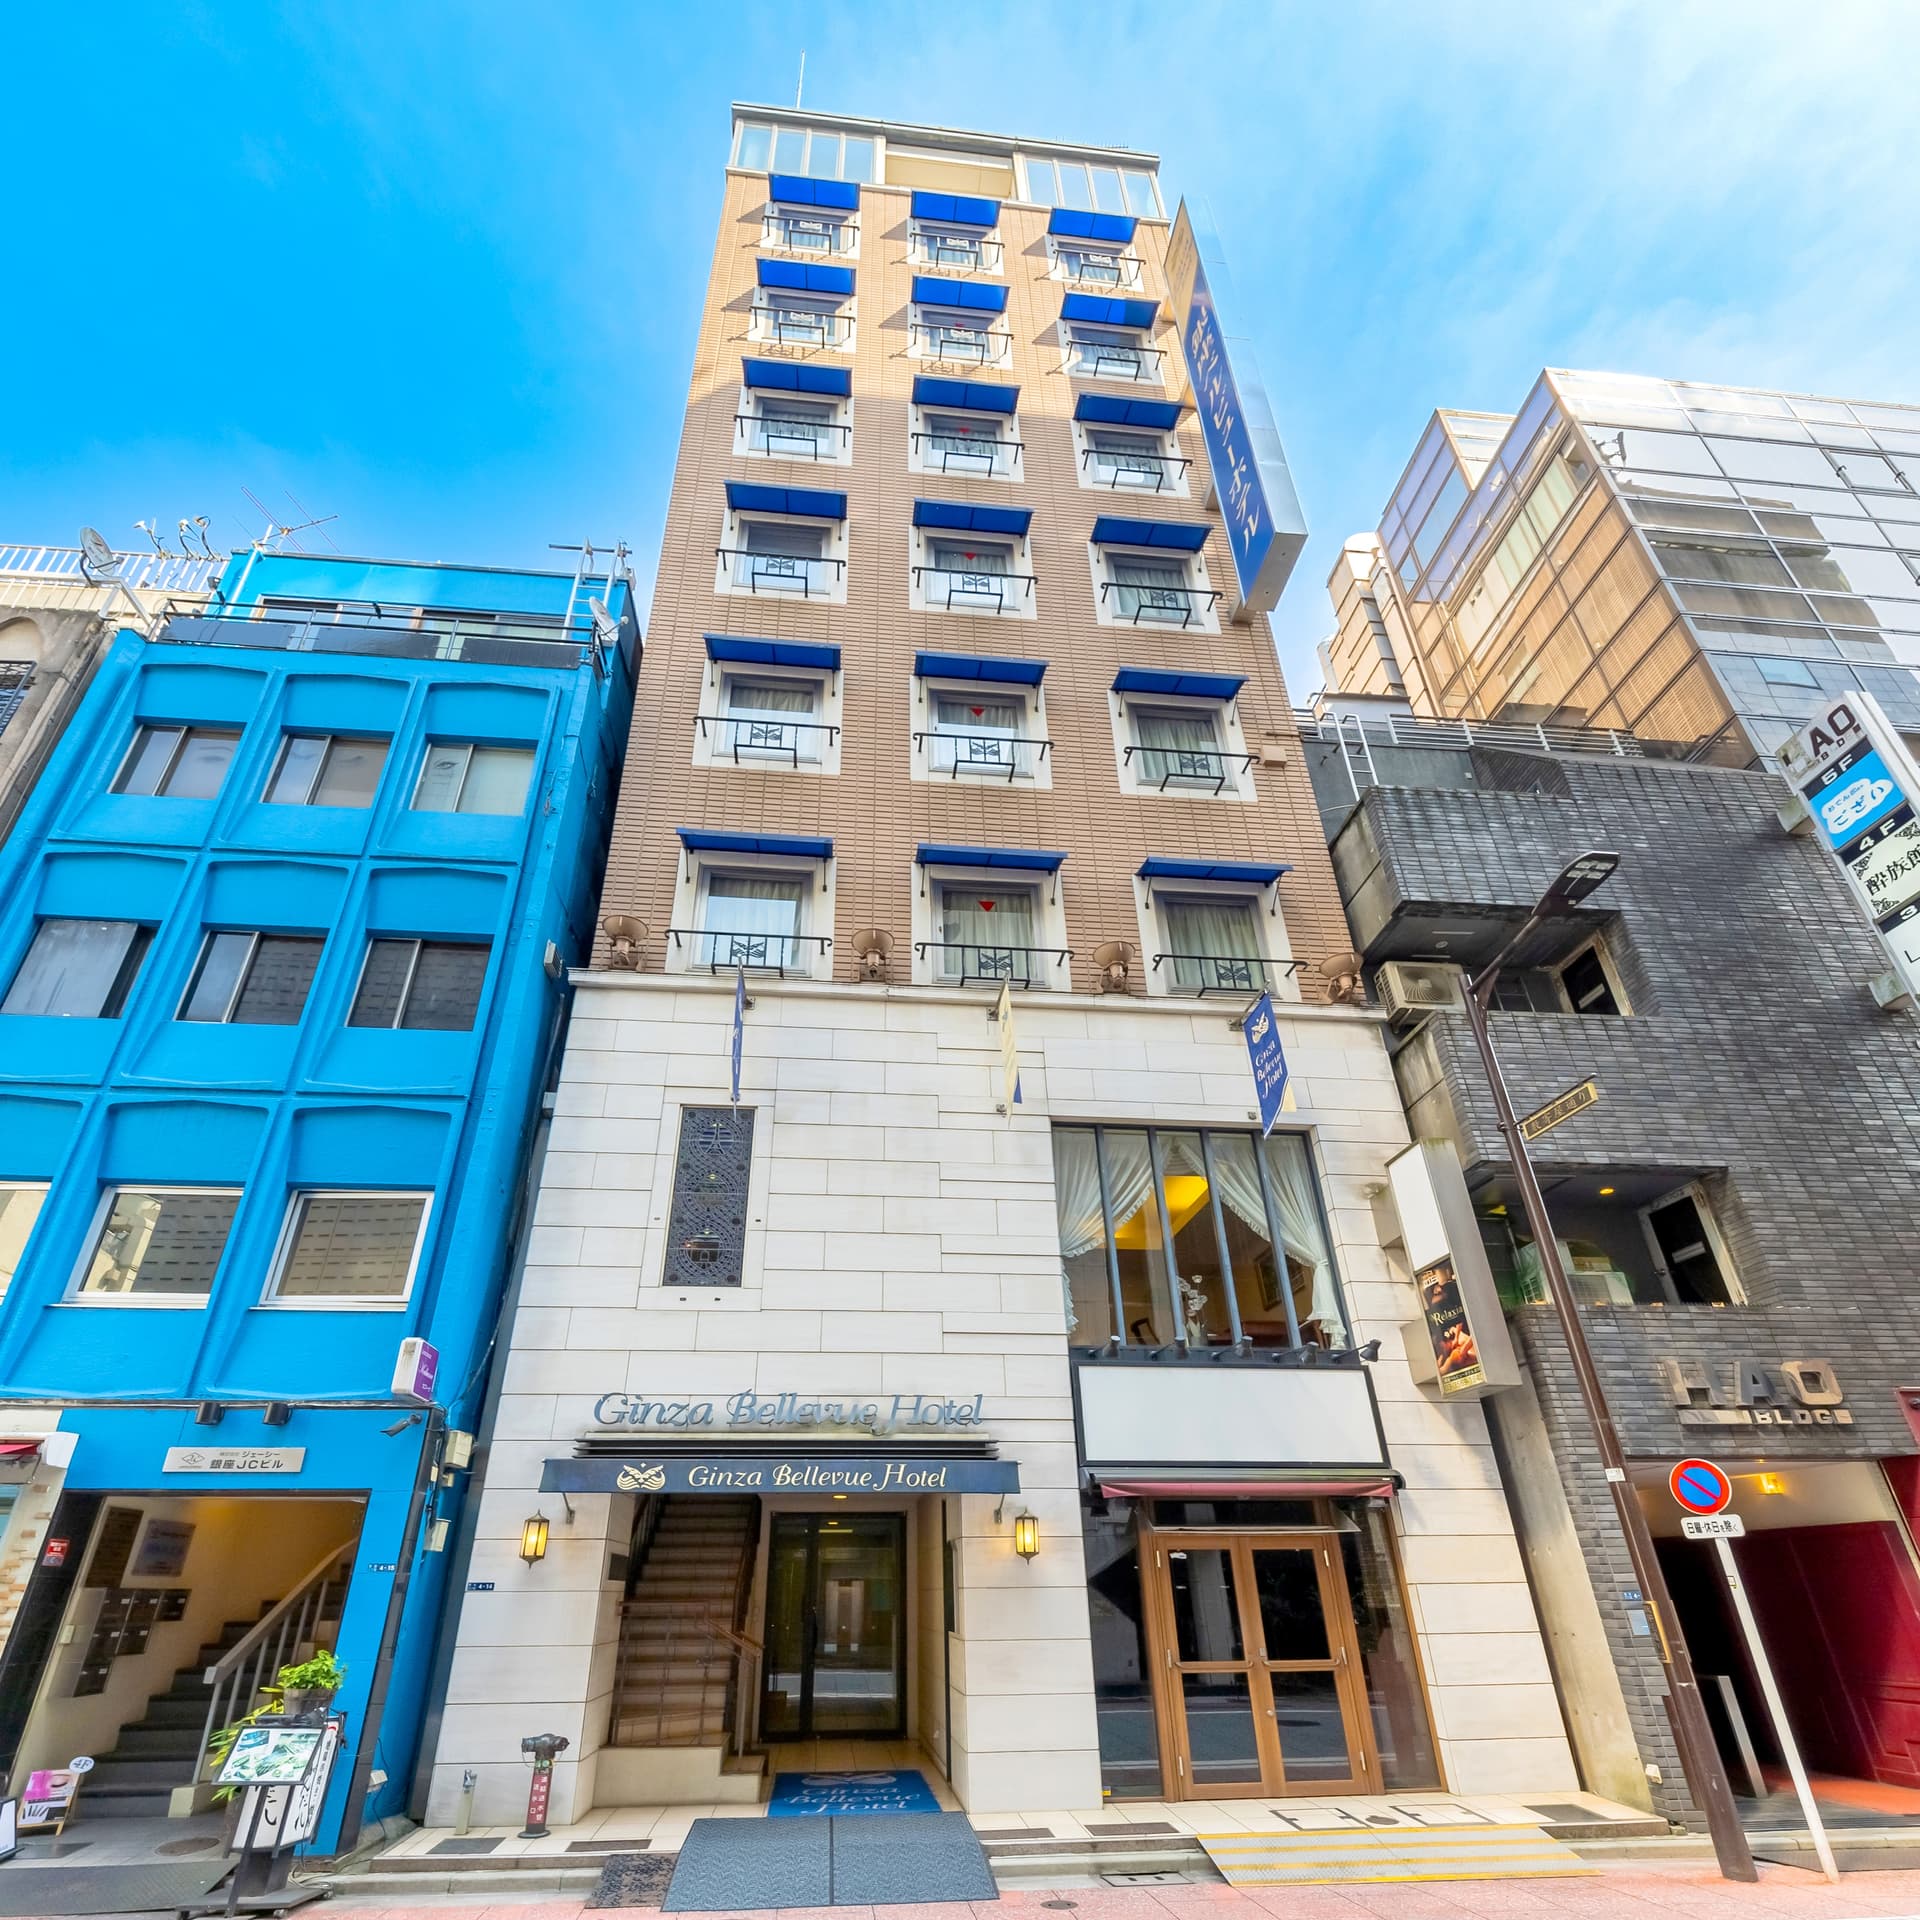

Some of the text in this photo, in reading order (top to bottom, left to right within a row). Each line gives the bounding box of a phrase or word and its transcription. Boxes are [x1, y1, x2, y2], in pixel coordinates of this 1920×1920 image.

[1191, 304, 1260, 557] 銀座ベルビューホテル
[1821, 754, 1853, 785] 5F
[1833, 785, 1884, 826] ござい
[1859, 818, 1896, 851] 4F
[1255, 1040, 1276, 1067] Ginza
[1262, 1062, 1283, 1099] Hotel
[1664, 1359, 1844, 1406] HAO
[593, 1388, 984, 1437] Ginza Bellevue Hotel
[687, 1463, 947, 1492] Ginza Bellevue Hotel
[783, 1793, 921, 1804] Bellevue
[800, 1800, 908, 1814] Hotel
[801, 1787, 900, 1796] Ginza
